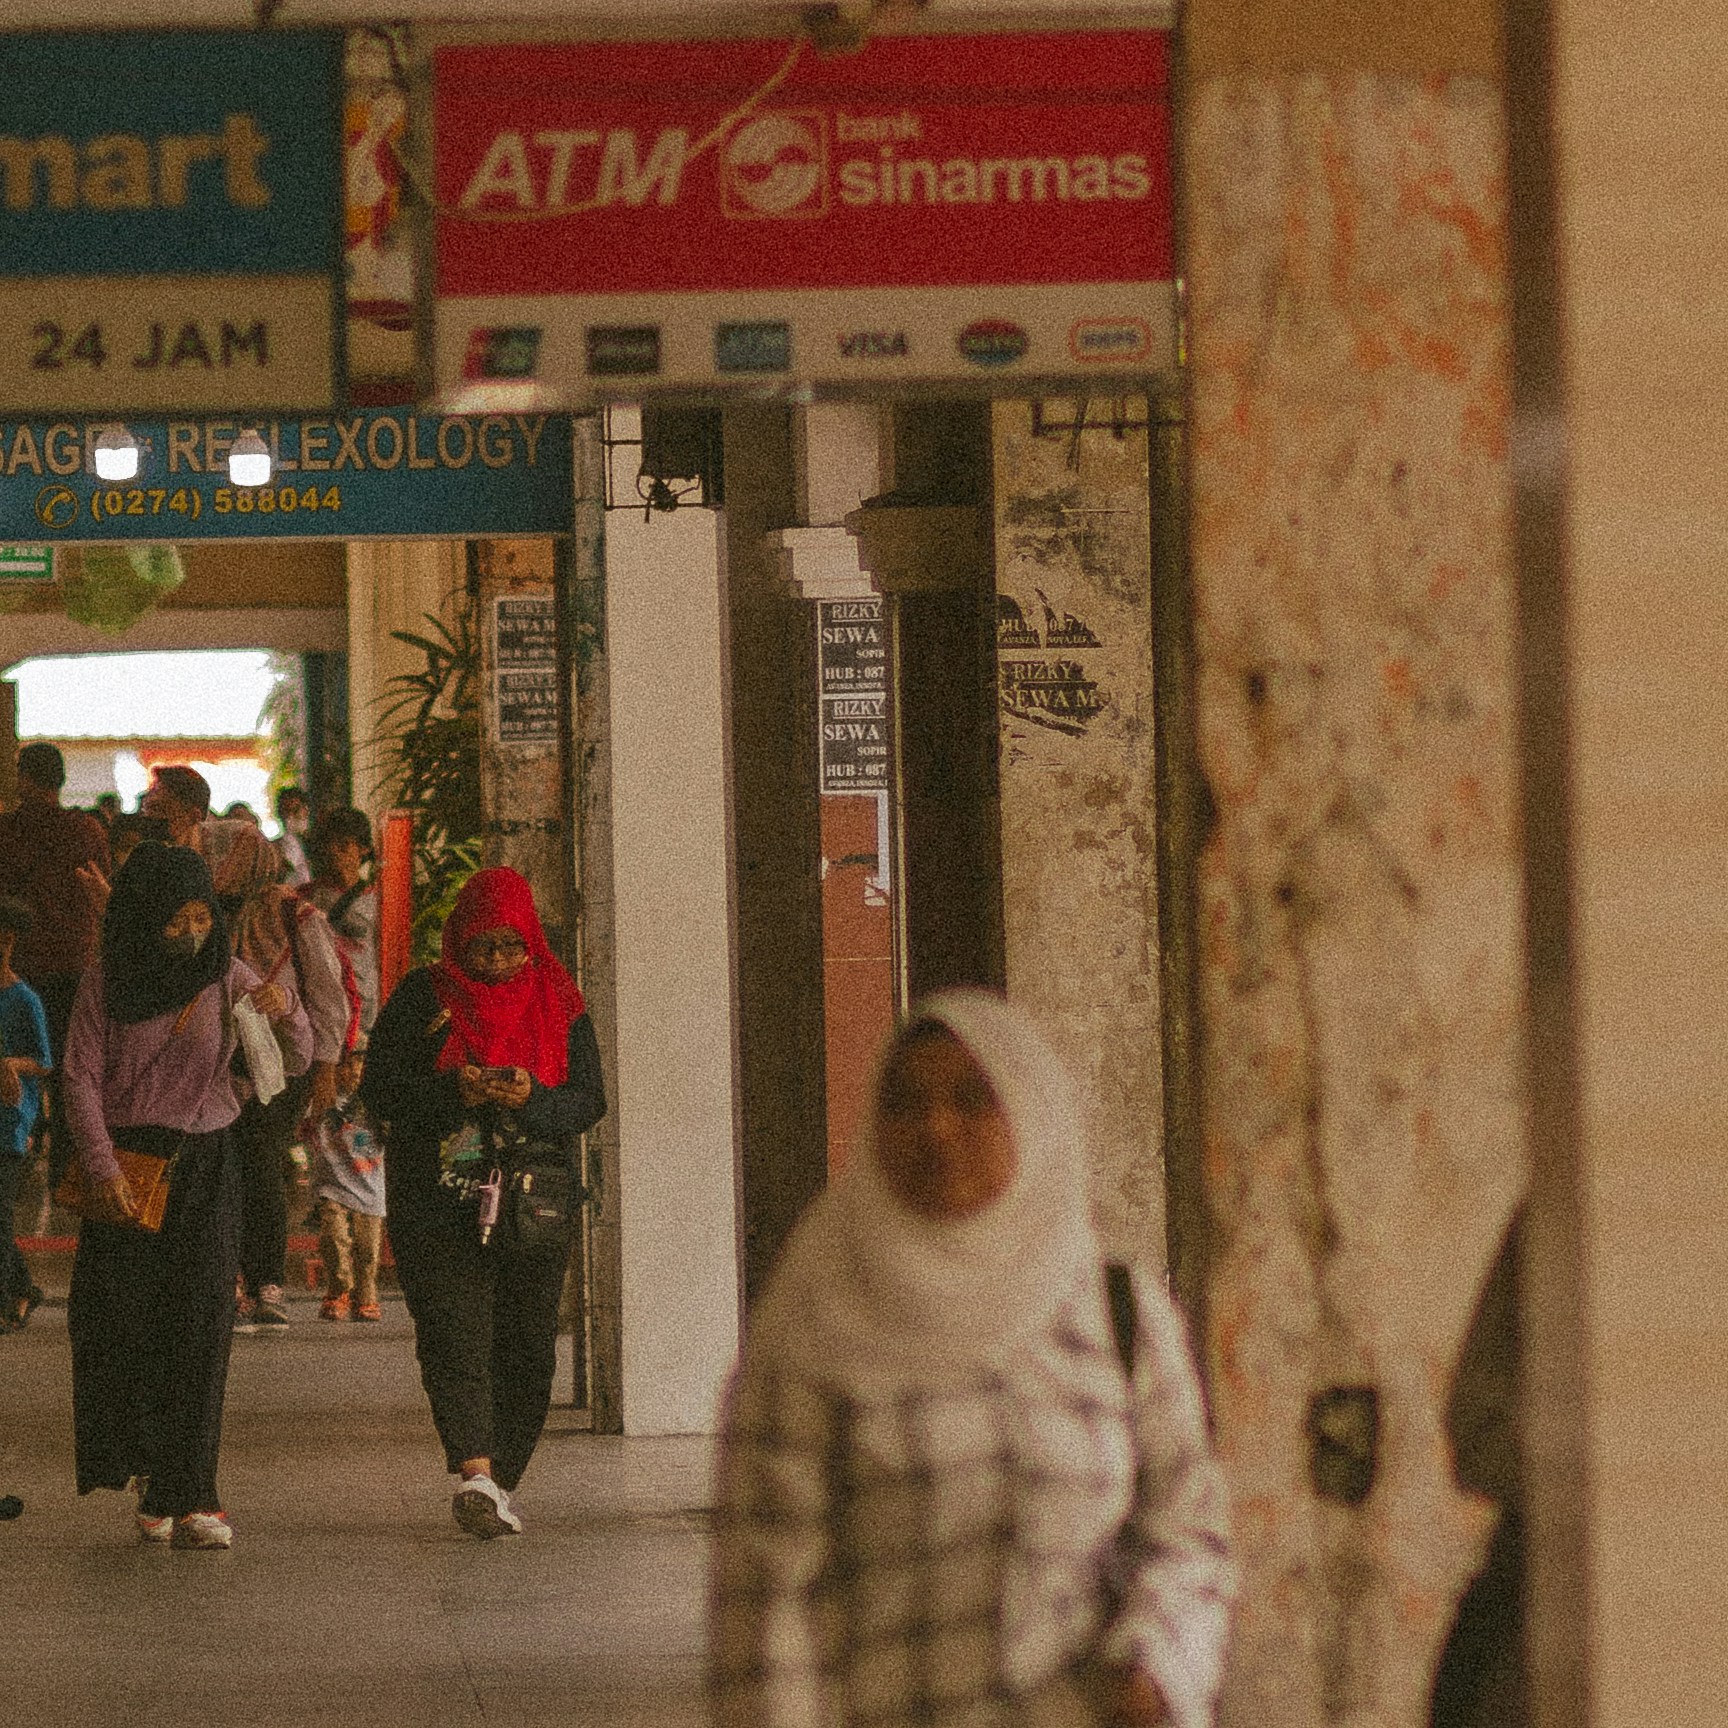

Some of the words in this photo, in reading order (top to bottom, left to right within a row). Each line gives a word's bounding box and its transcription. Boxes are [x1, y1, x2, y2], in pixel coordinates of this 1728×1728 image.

[837, 110, 924, 143] bank
[460, 128, 698, 209] ATM
[839, 146, 1151, 205] sinarmas
[31, 321, 106, 371] 24
[133, 321, 270, 370] JAM
[168, 416, 548, 474] RELEXOLOGY
[90, 486, 202, 523] (0274)
[213, 484, 343, 515] 588044
[831, 603, 883, 619] RIZKY
[822, 626, 879, 644] SEWA
[825, 666, 855, 680] HUB
[1012, 661, 1075, 680] RIZKY
[833, 700, 886, 716] RIZKY
[1002, 691, 1070, 710] SEWA
[824, 724, 880, 741] SEWA
[825, 765, 856, 777] HUB
